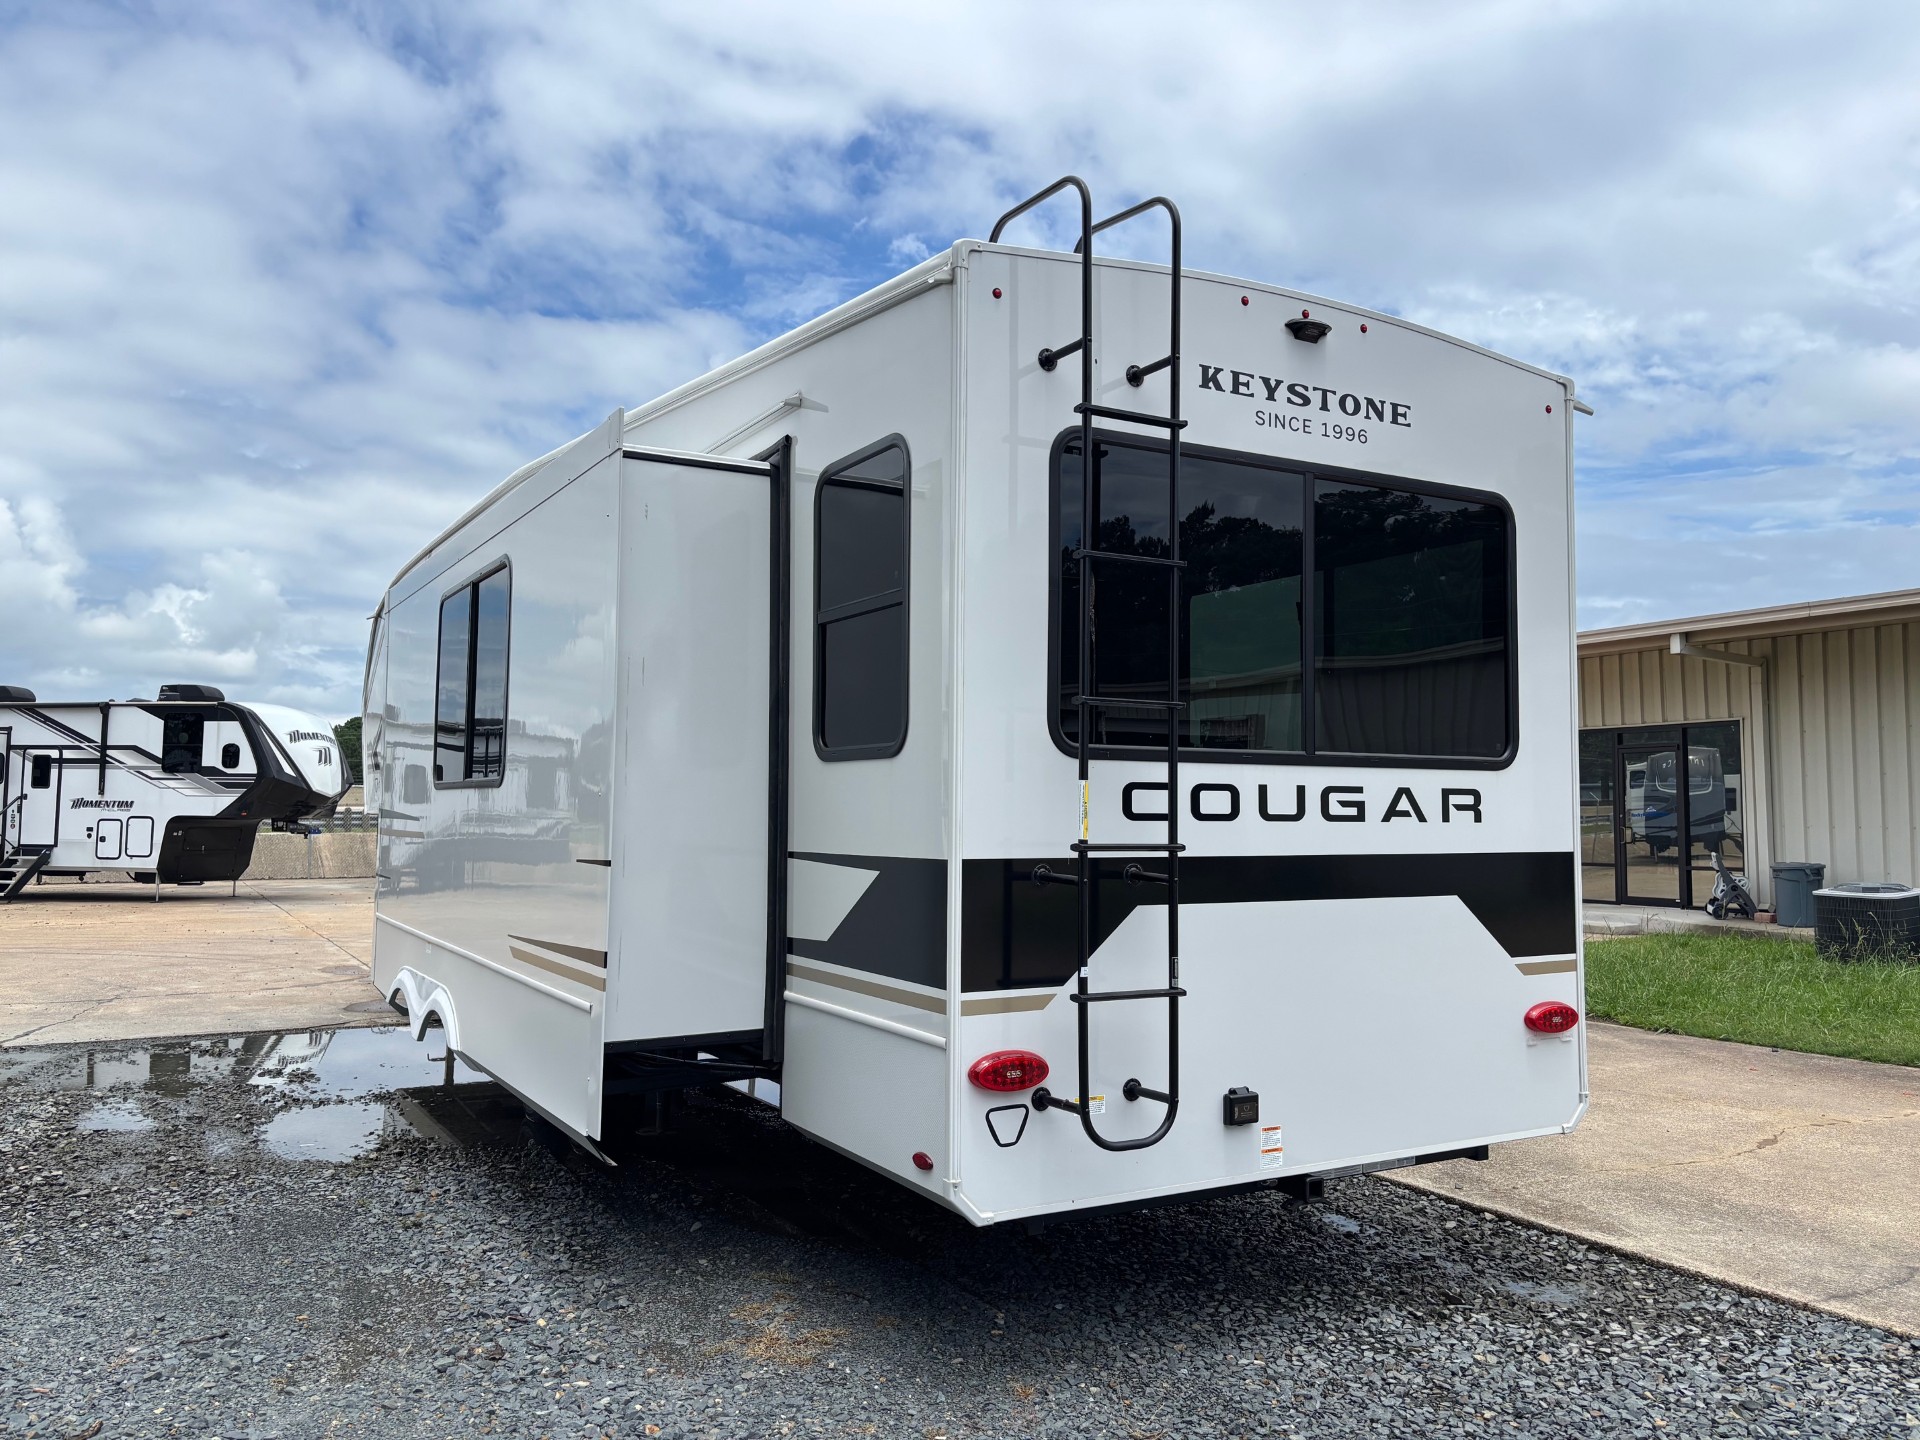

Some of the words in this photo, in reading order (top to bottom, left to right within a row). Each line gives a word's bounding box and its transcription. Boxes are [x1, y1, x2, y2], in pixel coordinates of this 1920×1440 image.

[1198, 363, 1412, 427] KEYSTONE
[1255, 410, 1312, 434] SINCE
[1321, 422, 1368, 443] 1996
[71, 797, 134, 809] MOMENTUM
[1121, 781, 1482, 823] COUGAR
